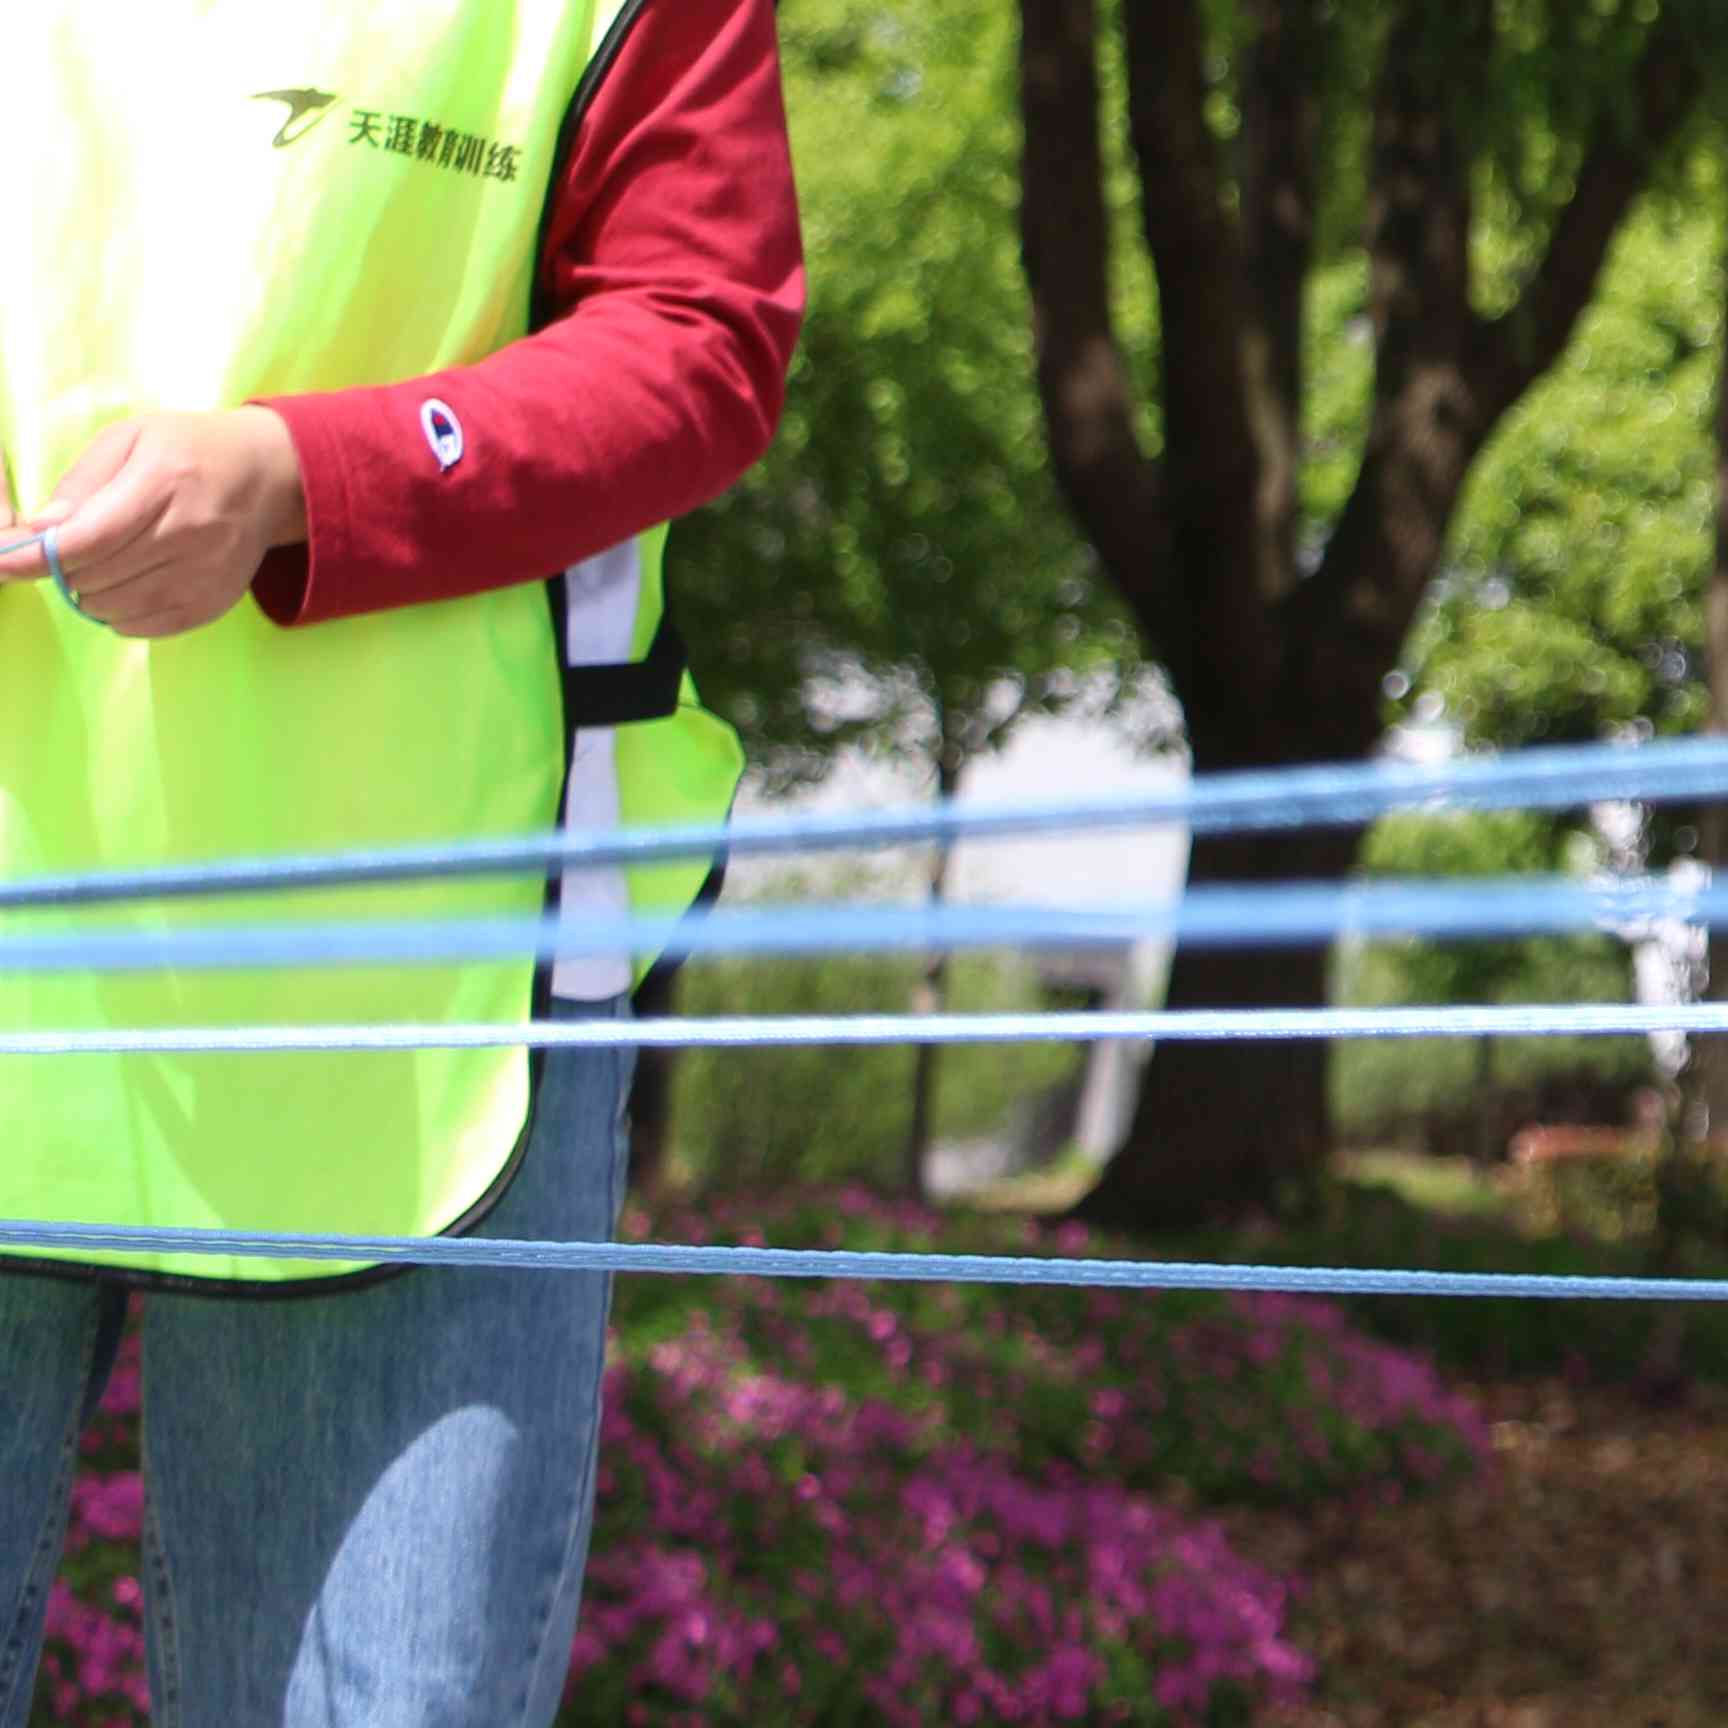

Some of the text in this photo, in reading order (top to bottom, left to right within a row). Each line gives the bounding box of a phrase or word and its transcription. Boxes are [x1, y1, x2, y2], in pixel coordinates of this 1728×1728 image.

[349, 110, 521, 182] 天涯教育训练
